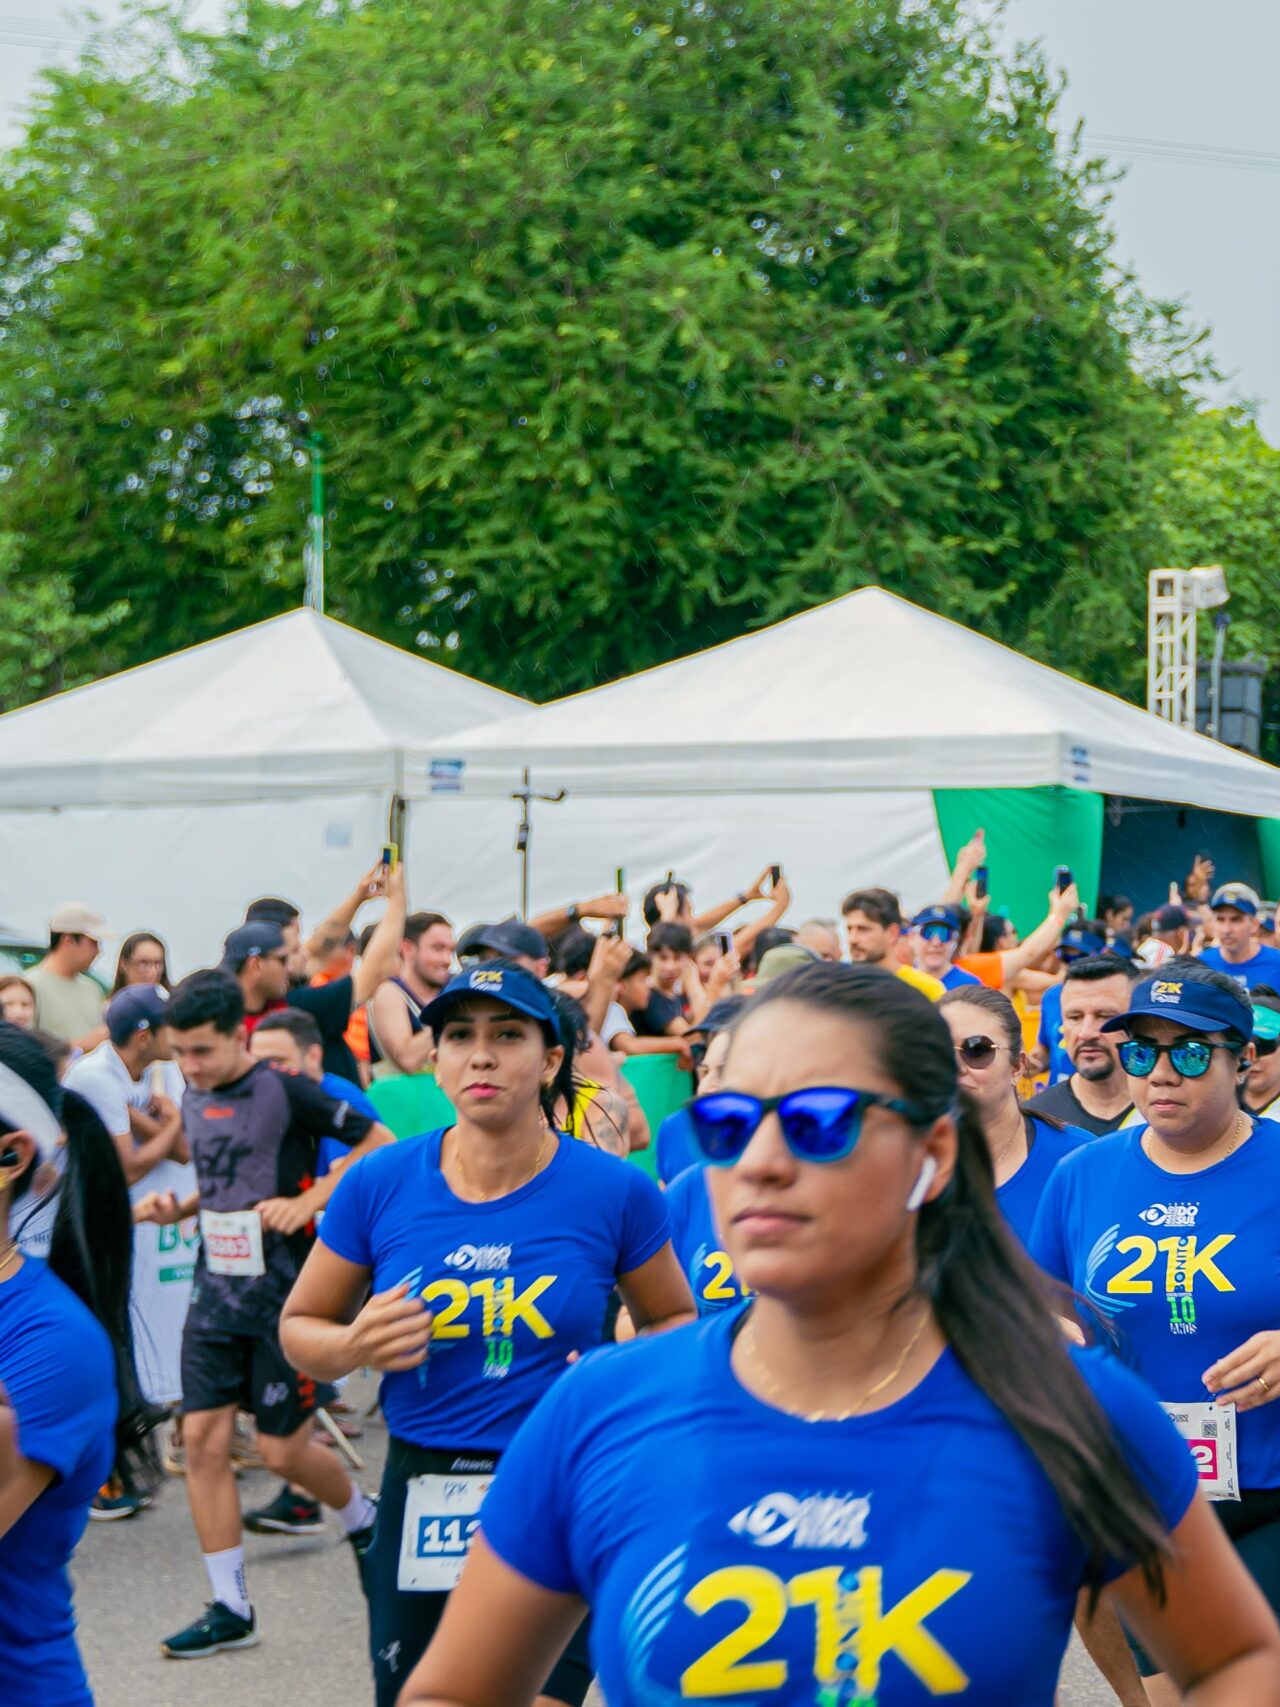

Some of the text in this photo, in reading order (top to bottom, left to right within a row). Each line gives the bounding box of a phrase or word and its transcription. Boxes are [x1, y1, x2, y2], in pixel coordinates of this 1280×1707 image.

[1107, 1234, 1236, 1293] 21K
[421, 1275, 558, 1339] 21K
[1166, 1296, 1196, 1323] 10
[681, 1565, 974, 1698] 21K
